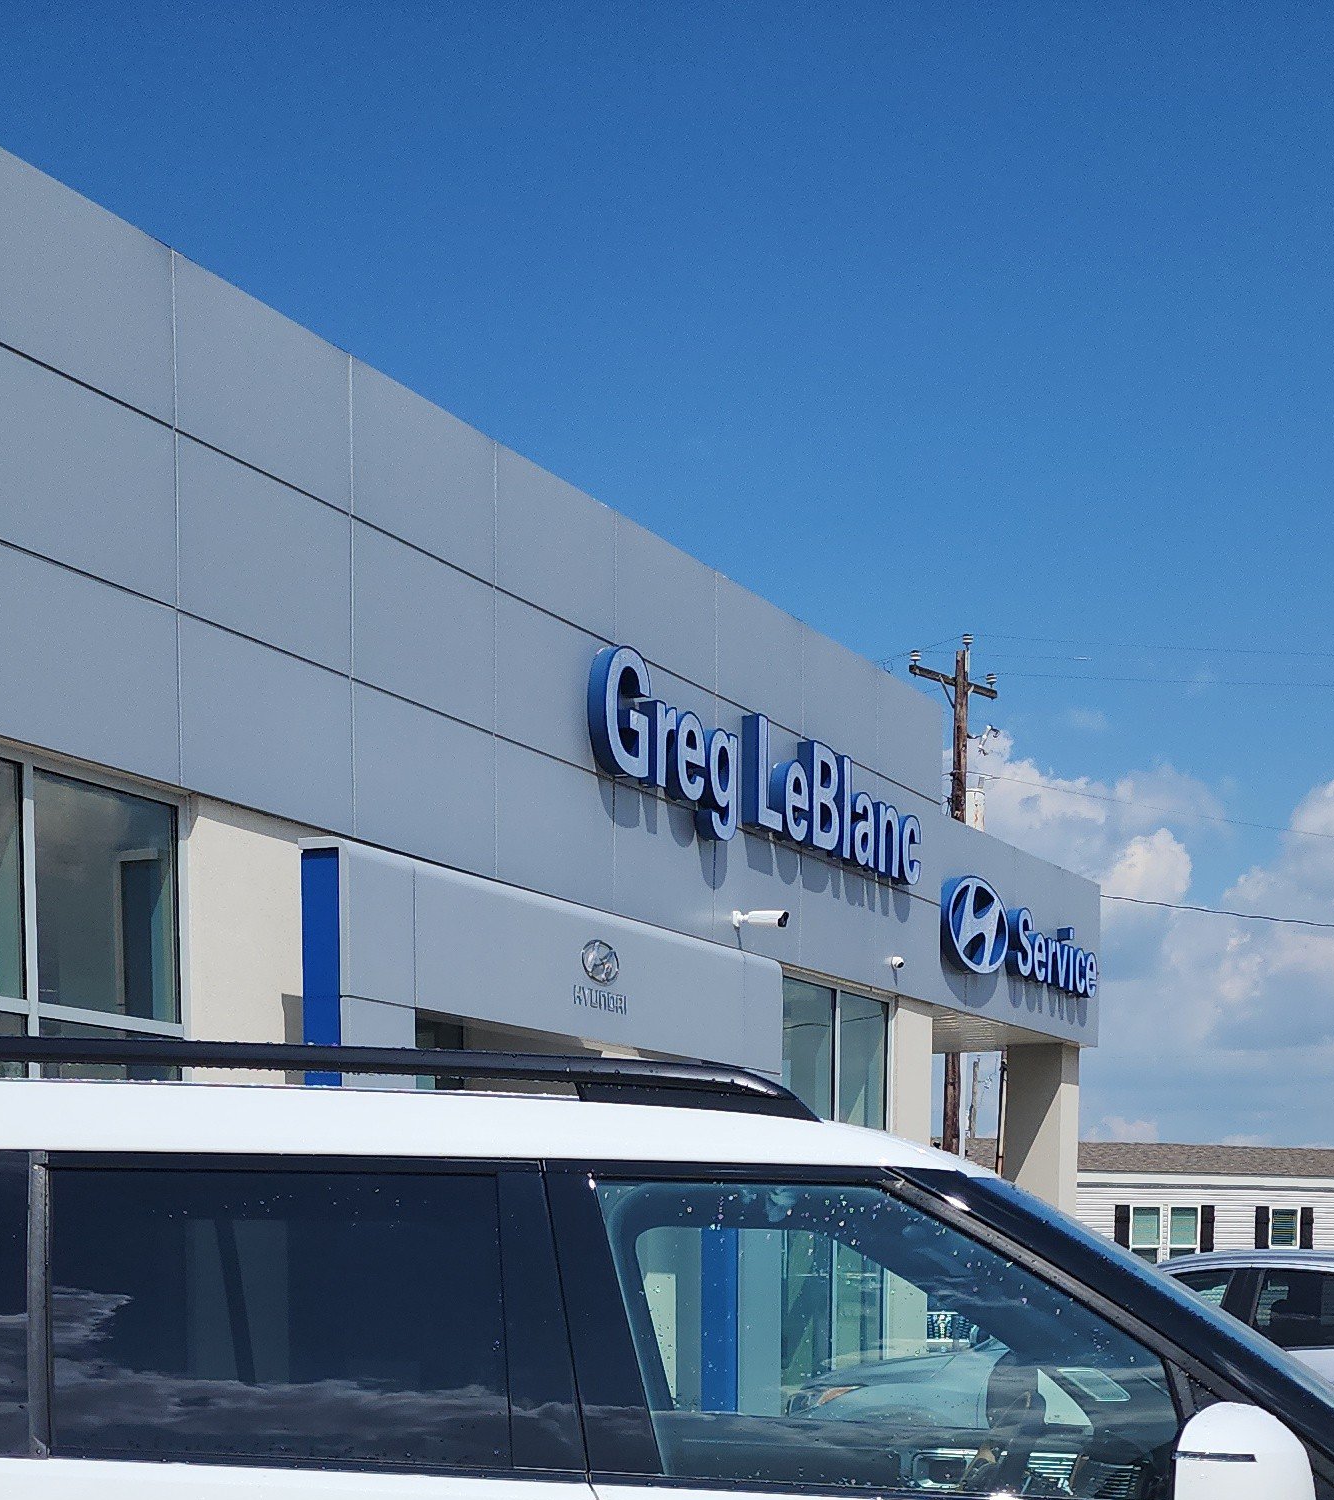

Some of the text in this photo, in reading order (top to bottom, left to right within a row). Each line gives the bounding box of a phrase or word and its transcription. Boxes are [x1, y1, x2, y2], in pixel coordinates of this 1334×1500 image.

[587, 645, 922, 885] Greg LeBlanc
[1008, 906, 1098, 998] Service
[572, 984, 627, 1015] HYUNDAI
